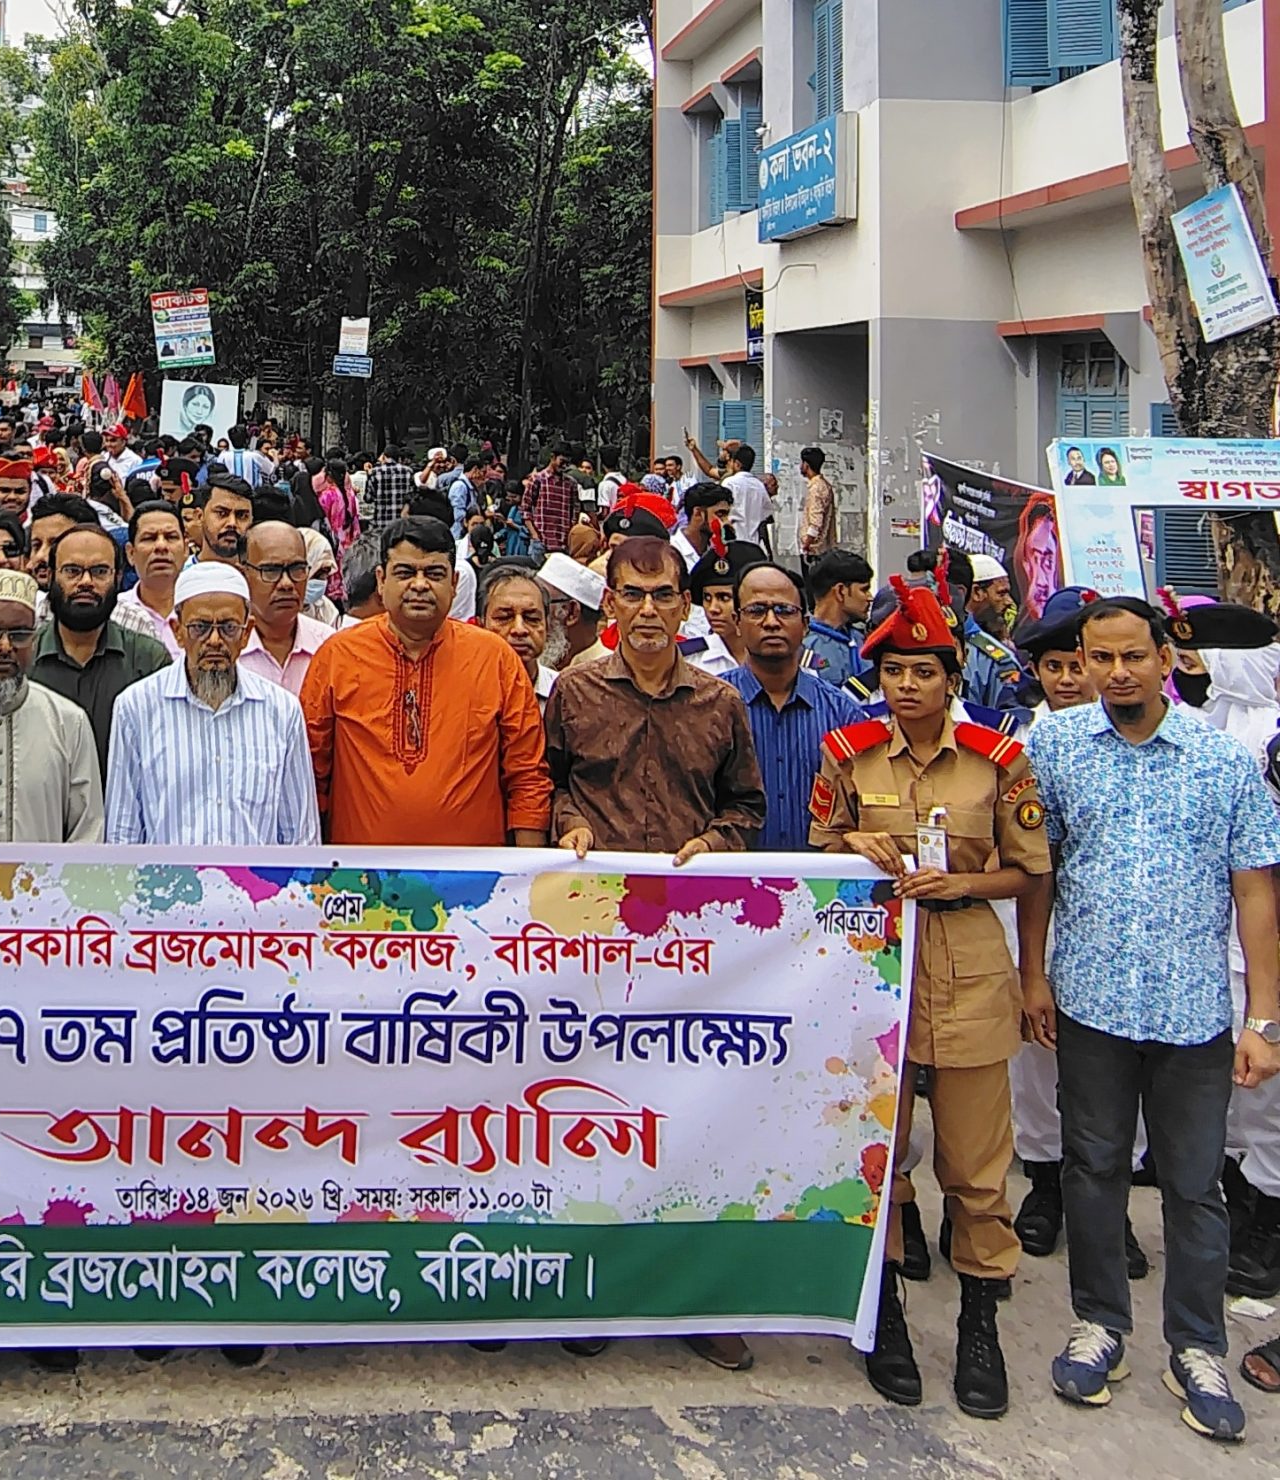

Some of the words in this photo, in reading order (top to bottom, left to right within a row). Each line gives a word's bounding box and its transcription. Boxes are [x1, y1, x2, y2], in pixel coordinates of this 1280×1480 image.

[768, 143, 790, 185] কলা
[791, 127, 834, 172] ভবন-২
[323, 894, 364, 921] প্রেম
[815, 901, 887, 936] পবিত্রতা
[124, 929, 317, 975] ব্রজমোহন
[327, 931, 477, 982] কলেজ,
[489, 922, 715, 975] বরিশাল-এর
[41, 1009, 138, 1064] তম
[150, 988, 330, 1065] প্রতিষ্ঠা
[341, 989, 529, 1065] বার্ষিকী
[539, 997, 793, 1067] উপলক্ষ্যে
[184, 1186, 210, 1211] ১৪
[216, 1187, 250, 1214] জুন
[256, 1187, 314, 1213] ২০২৬
[408, 1186, 462, 1210] সকাল
[468, 1187, 524, 1210] ১১.০০
[531, 1181, 553, 1212] টা
[41, 1245, 246, 1309] ব্রজমোহন
[253, 1250, 401, 1313] কলেজ,
[416, 1232, 574, 1302] বরিশাল
